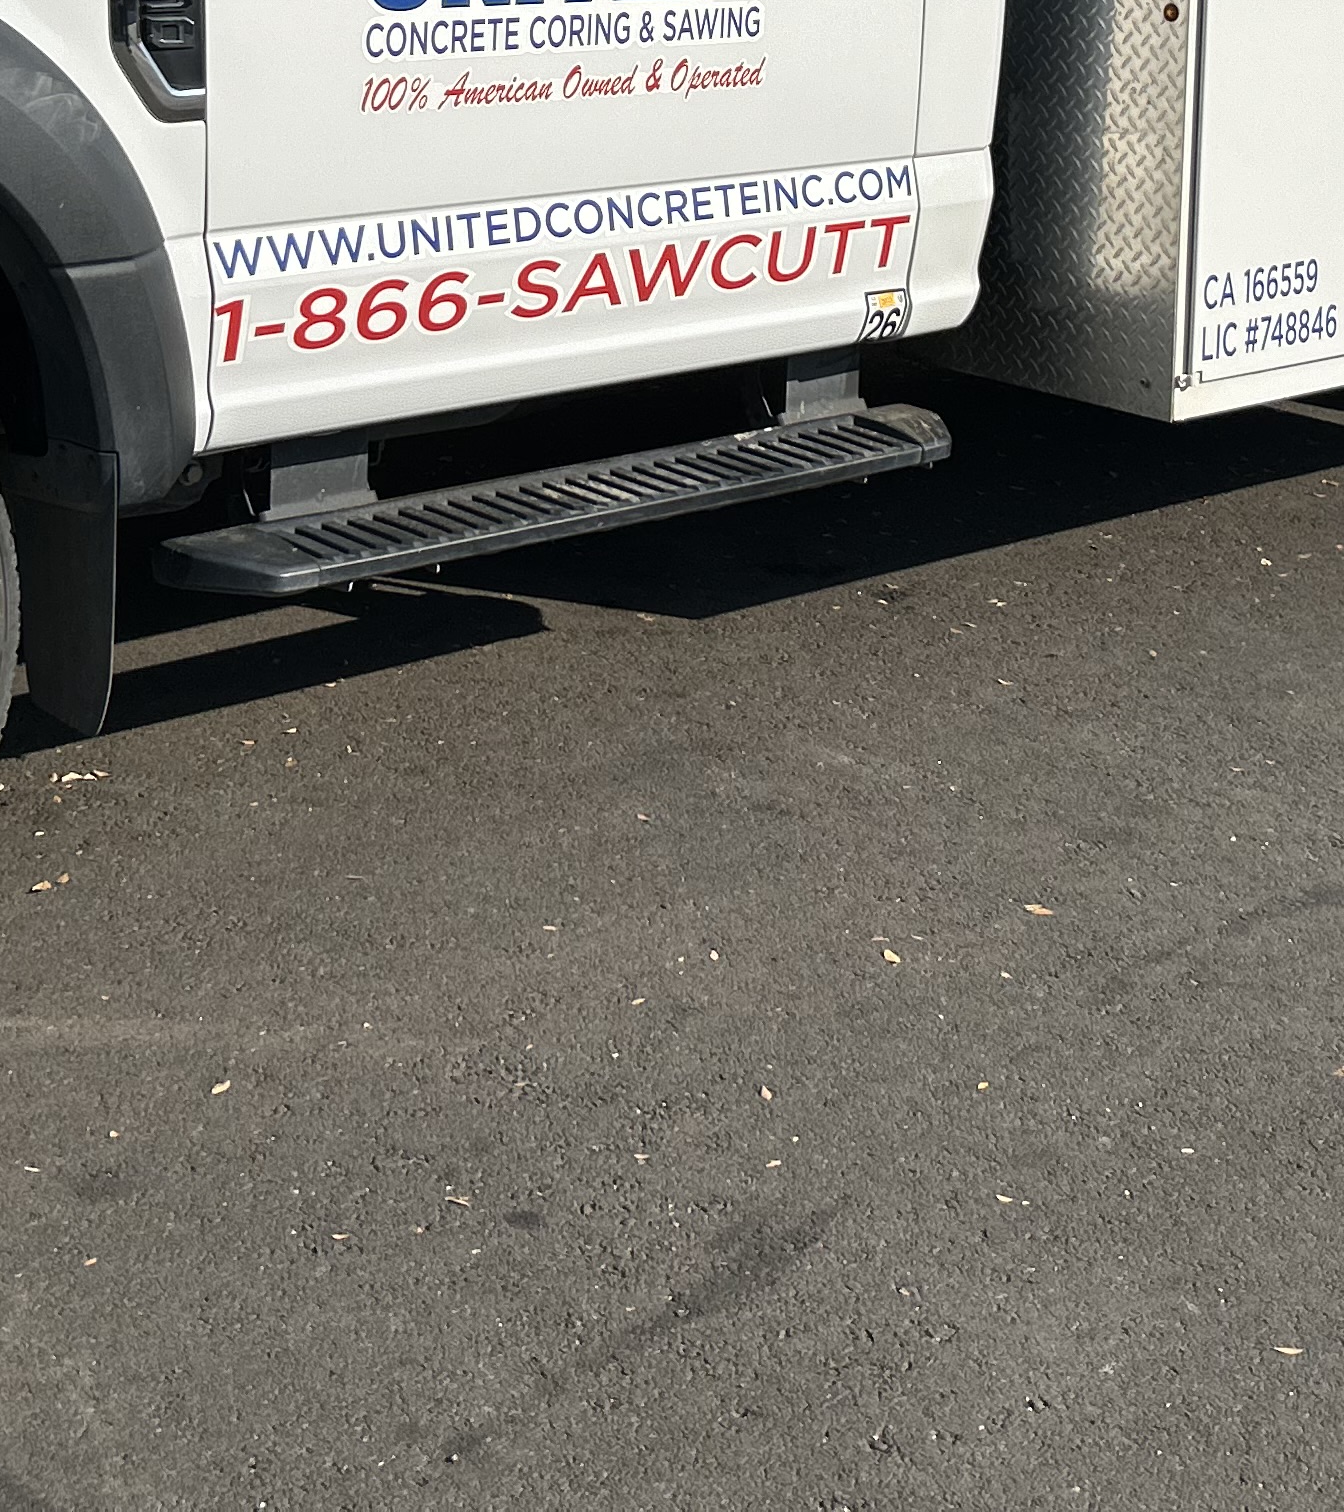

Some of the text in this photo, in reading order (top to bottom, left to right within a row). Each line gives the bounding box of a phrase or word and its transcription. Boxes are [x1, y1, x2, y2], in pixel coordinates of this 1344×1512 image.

[366, 6, 760, 58] CONCRETE CORING & SAWING
[361, 56, 767, 112] 100% American Owned & Operated
[213, 164, 912, 279] WWW.UNITEDCONCRETEINC.COM
[215, 215, 911, 362] 1-866-SAWCUTT
[1203, 258, 1318, 310] CA 166559
[860, 307, 901, 342] 26
[1201, 303, 1337, 361] LIC #748846
